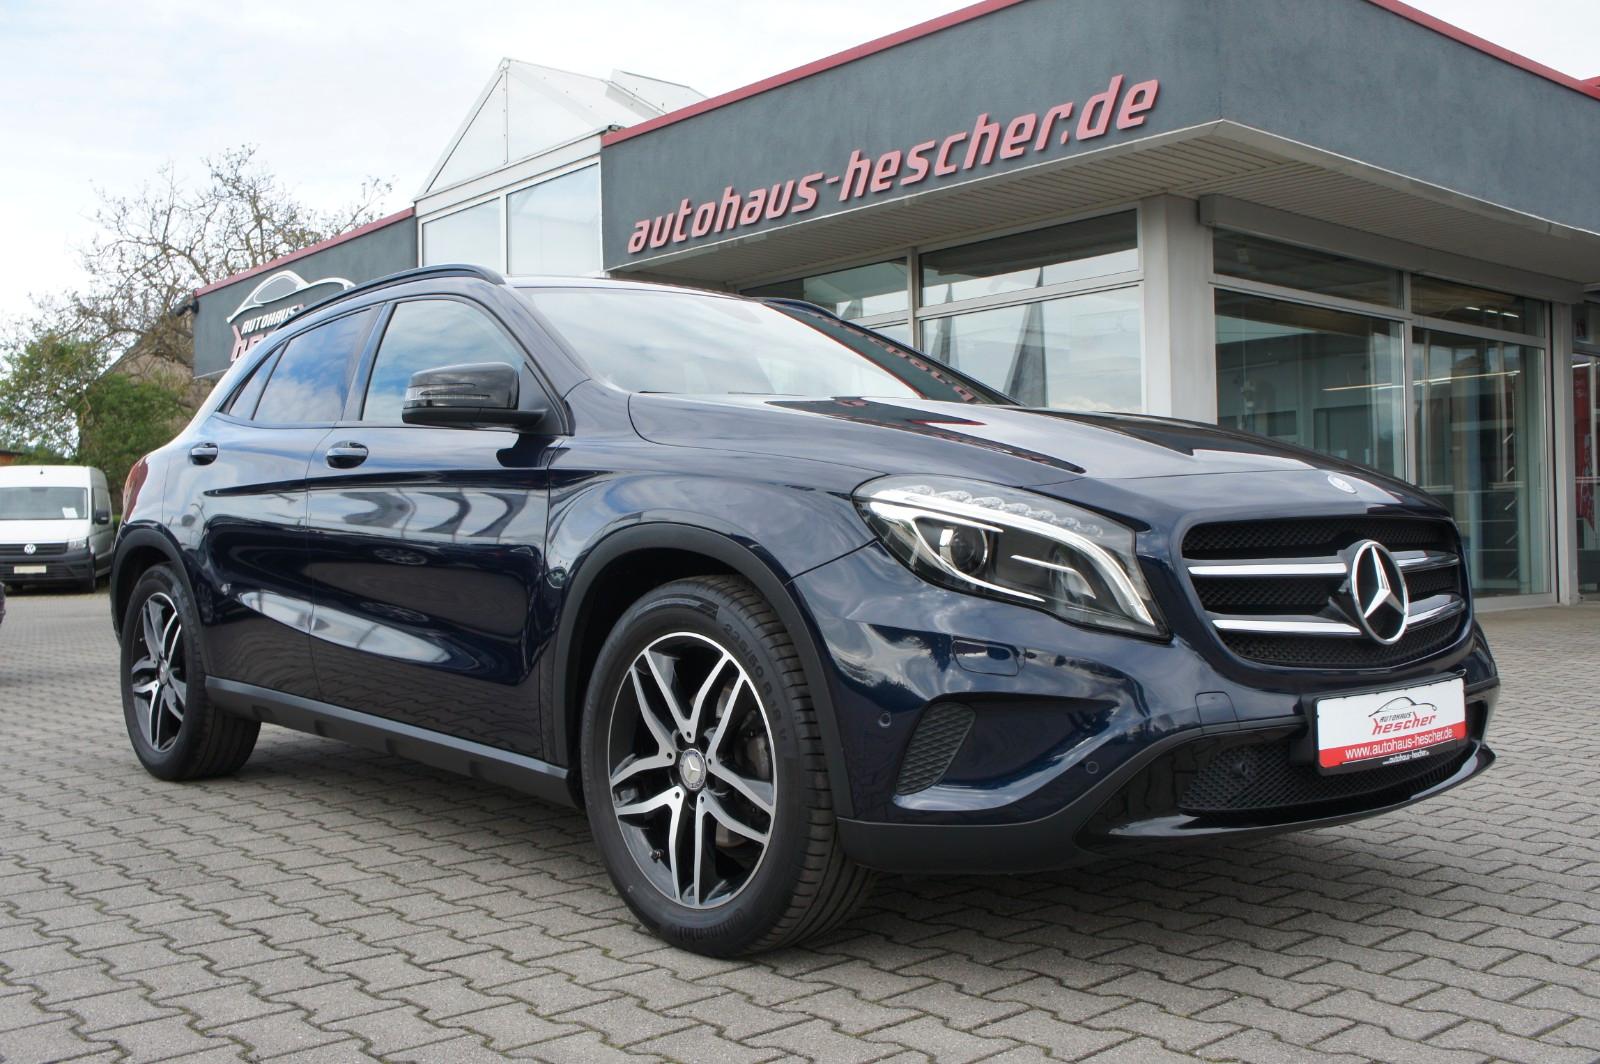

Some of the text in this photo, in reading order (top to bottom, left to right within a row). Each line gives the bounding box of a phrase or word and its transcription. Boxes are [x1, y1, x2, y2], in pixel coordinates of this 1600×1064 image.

[627, 74, 1160, 254] autohaus-hescher.de
[1371, 711, 1437, 736] hescher
[1379, 711, 1412, 723] AUTOHAUS
[1345, 727, 1453, 760] www.autohaus-hescher.de
